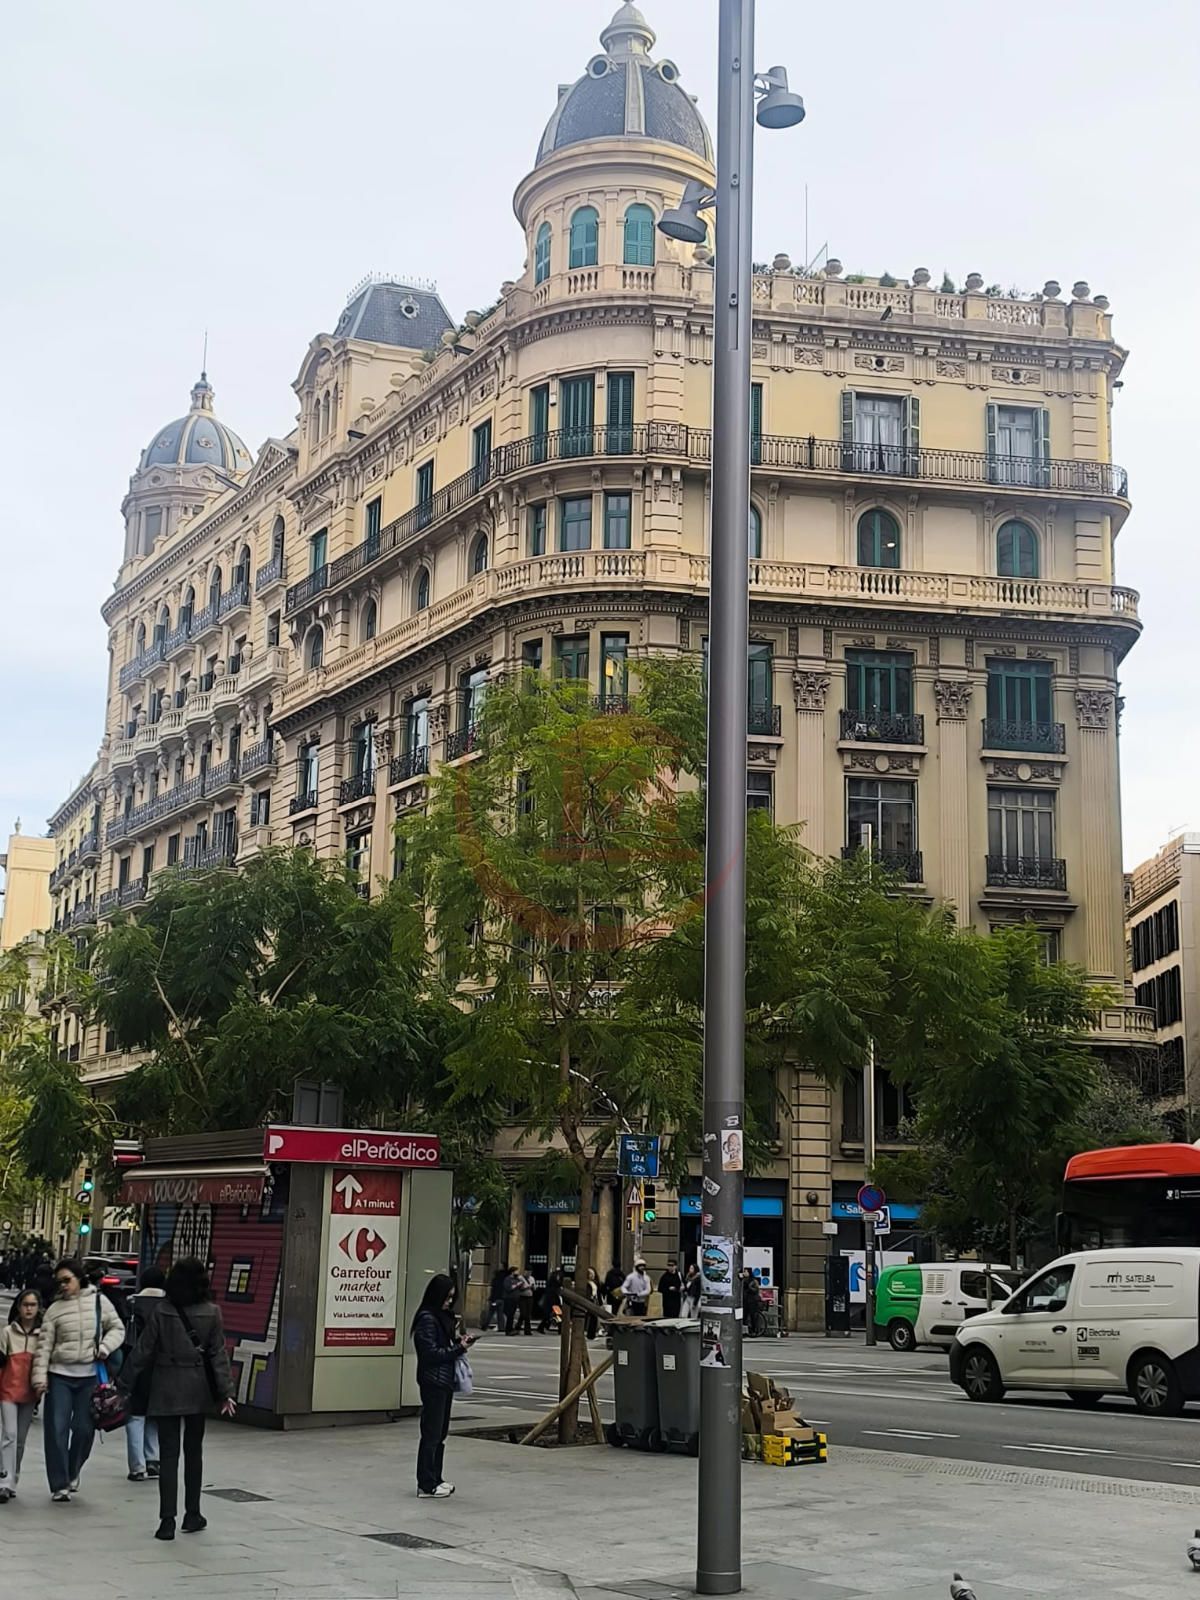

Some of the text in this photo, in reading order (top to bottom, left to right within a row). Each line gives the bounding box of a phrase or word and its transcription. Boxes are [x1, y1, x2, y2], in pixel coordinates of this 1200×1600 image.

[631, 1153, 648, 1162] tax
[368, 1199, 395, 1209] minut
[331, 1265, 392, 1279] Carrefour
[339, 1281, 382, 1293] market
[348, 1295, 385, 1303] LAIETANA
